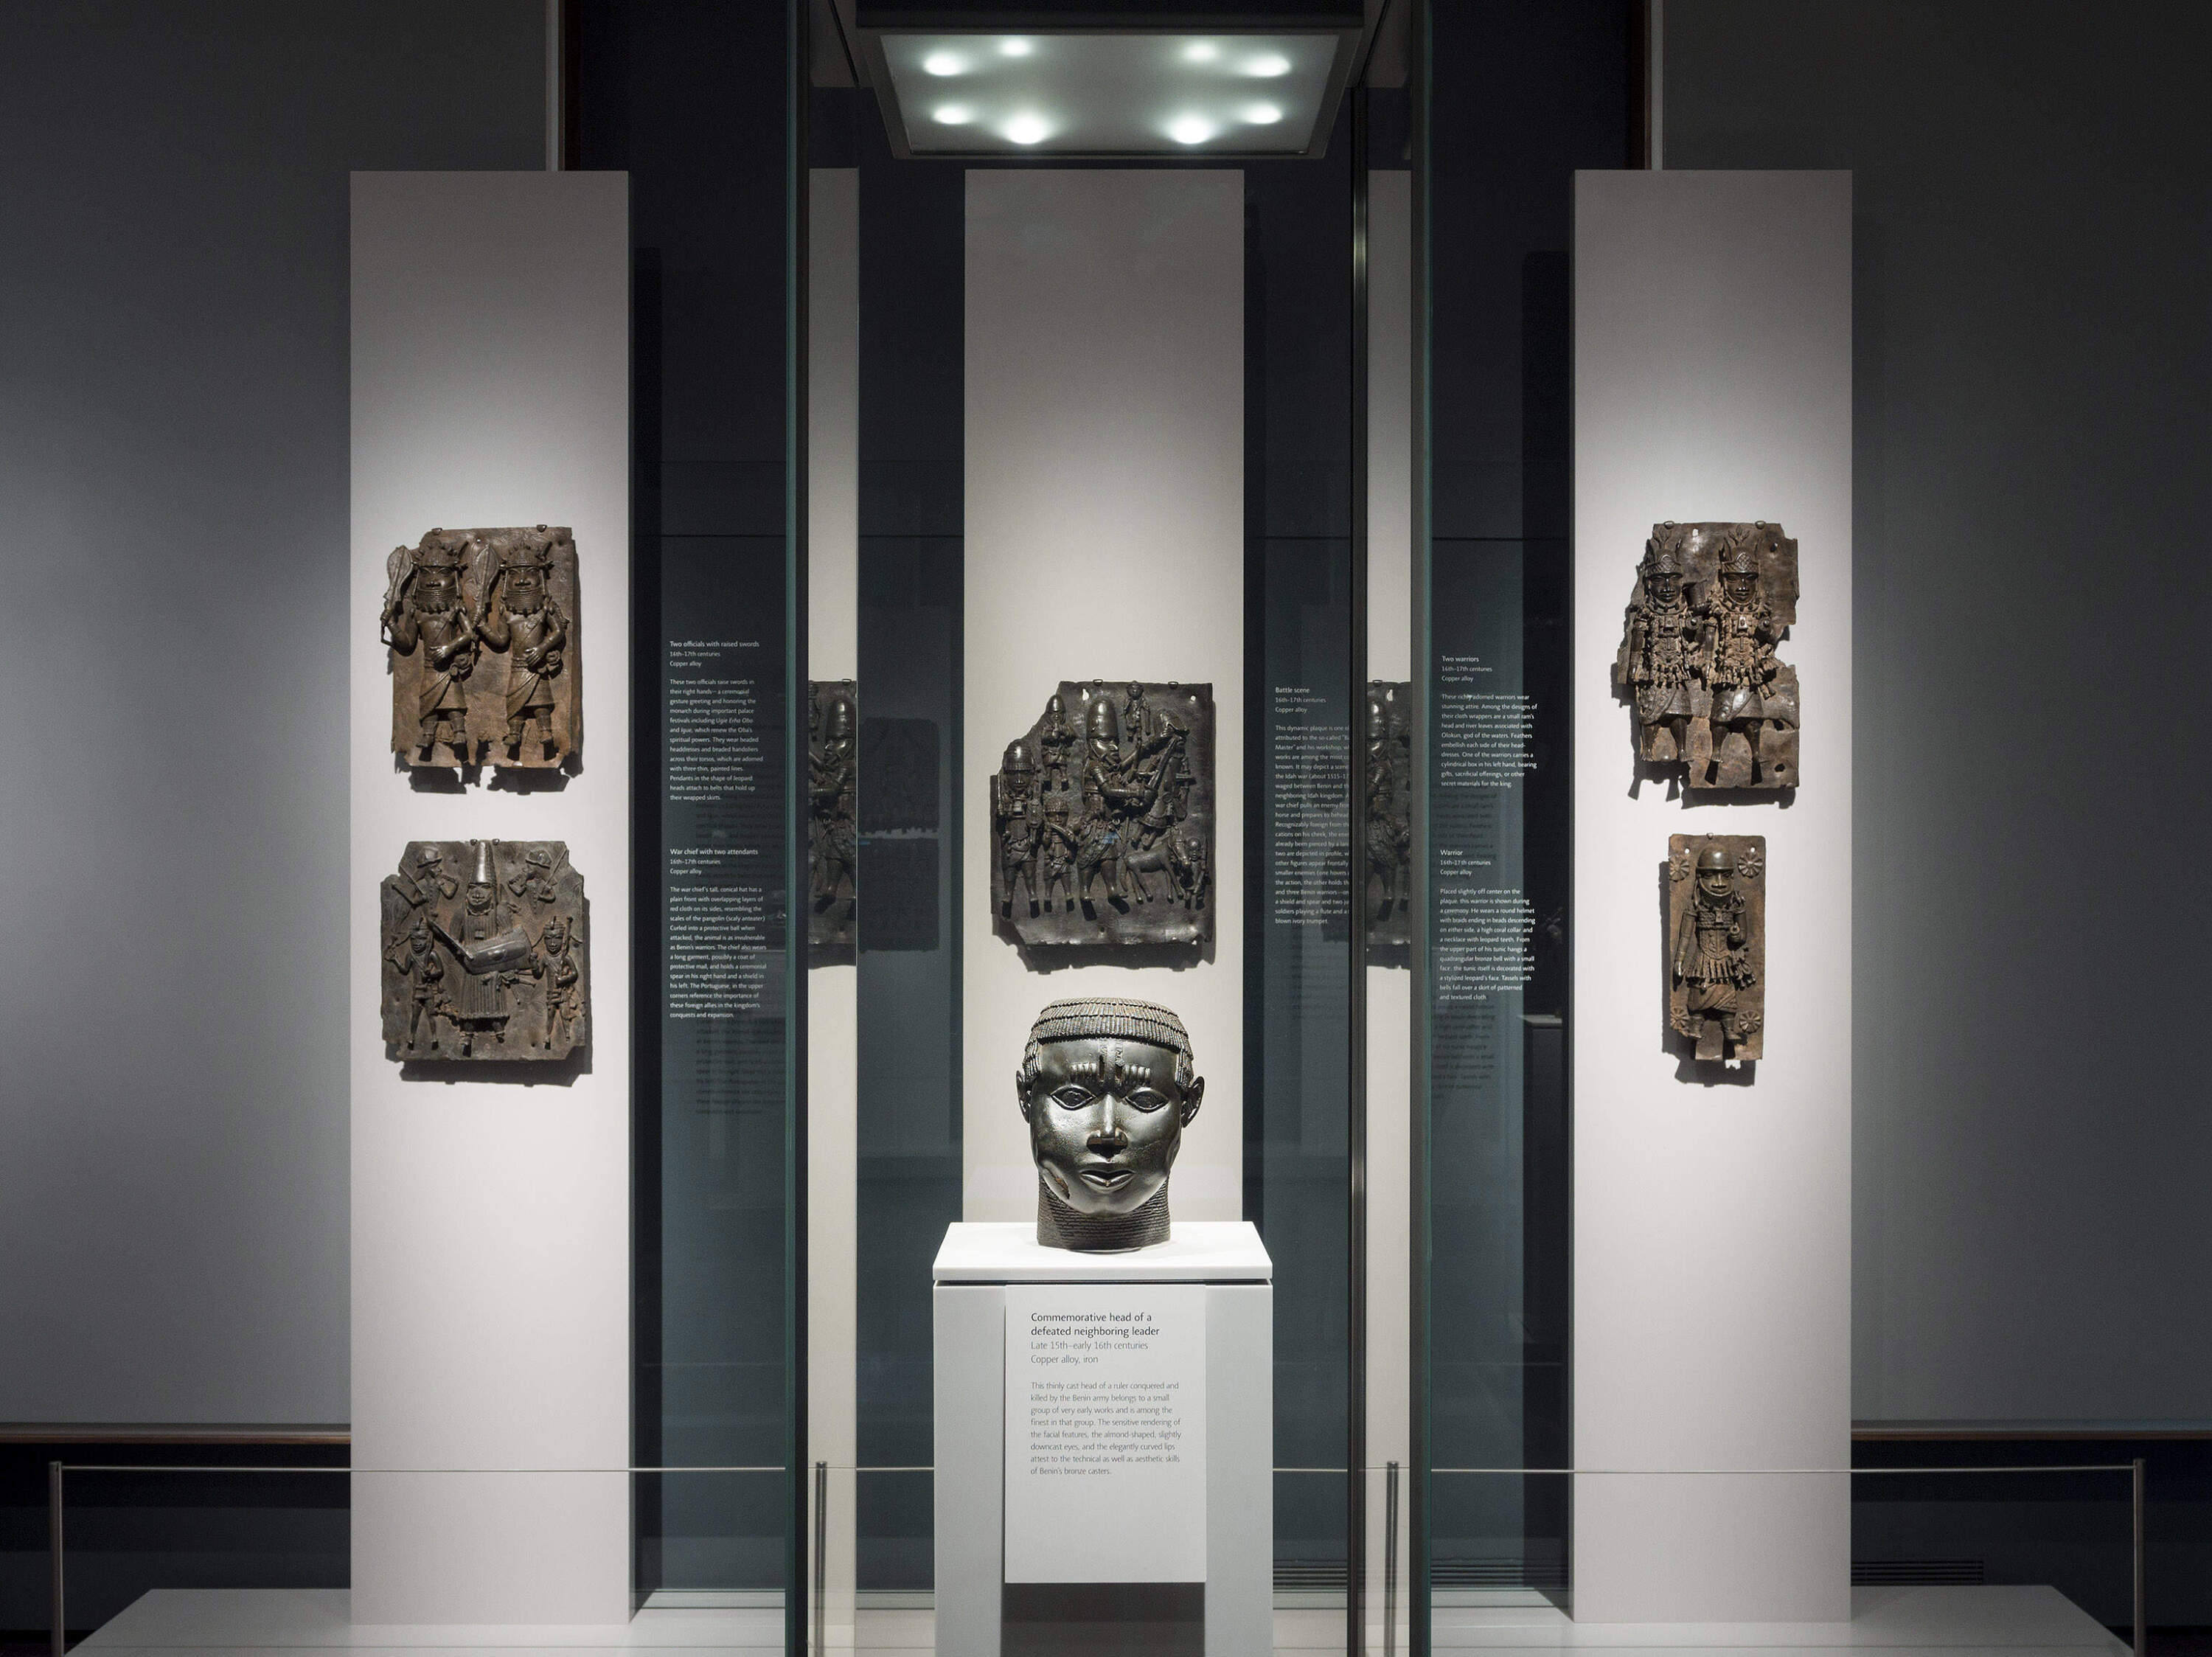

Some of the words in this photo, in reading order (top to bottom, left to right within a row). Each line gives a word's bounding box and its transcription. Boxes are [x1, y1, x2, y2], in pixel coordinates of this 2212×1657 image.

[1031, 1313, 1107, 1321] Commemorative
[1110, 1313, 1132, 1321] head
[1134, 1313, 1144, 1321] of
[1031, 1327, 1071, 1335] defeated
[1074, 1327, 1130, 1338] neighboring
[1131, 1327, 1160, 1335] leader
[1031, 1341, 1048, 1349] Late
[1050, 1341, 1091, 1352] 15th–early
[1093, 1341, 1112, 1349] 16th
[1114, 1341, 1148, 1349] centuries
[1031, 1355, 1060, 1365] Copper
[1061, 1355, 1081, 1365] alloy,
[1083, 1355, 1099, 1363] iron
[1046, 1382, 1064, 1391] thinly
[1130, 1382, 1165, 1391] conquered
[1050, 1394, 1058, 1403] by
[1111, 1394, 1136, 1403] belongs
[1077, 1406, 1092, 1415] early
[1141, 1419, 1172, 1428] rendering
[1158, 1431, 1181, 1439] slightly
[1110, 1443, 1138, 1452] elegantly
[1164, 1443, 1175, 1452] lips
